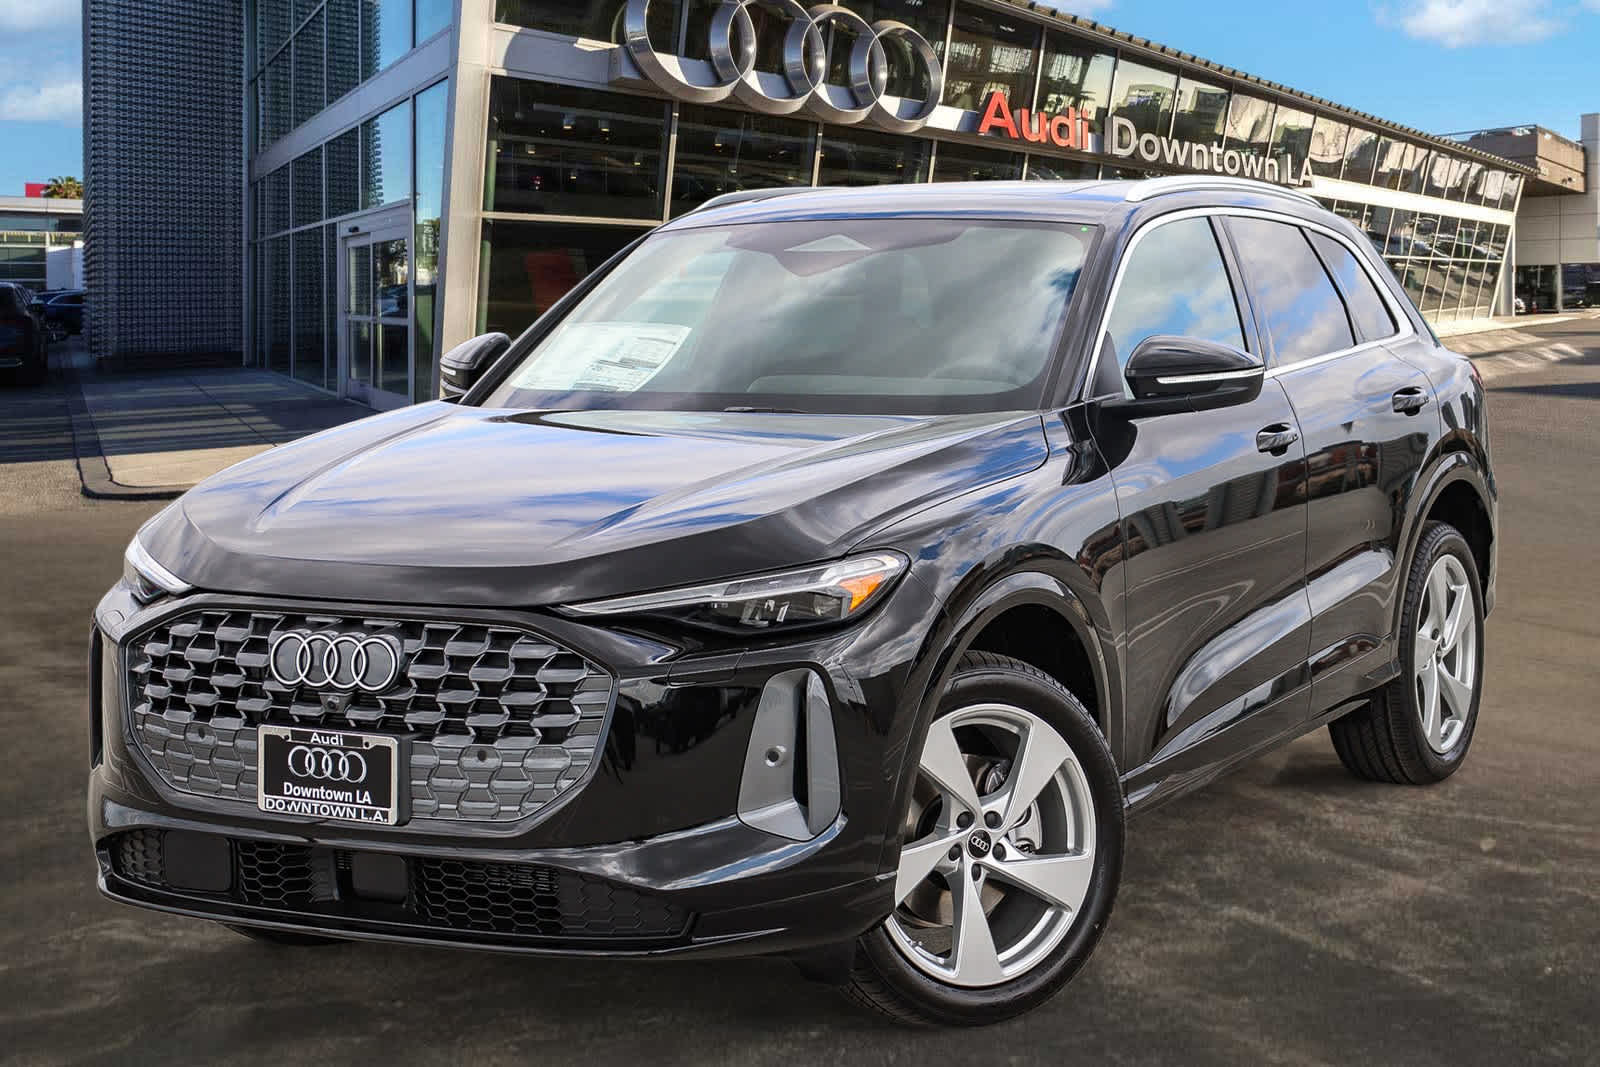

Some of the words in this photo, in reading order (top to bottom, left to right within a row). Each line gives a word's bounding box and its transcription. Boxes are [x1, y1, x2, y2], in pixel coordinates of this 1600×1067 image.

[978, 91, 1089, 151] Audi
[1109, 115, 1279, 183] Downtown
[1285, 154, 1315, 186] LA
[310, 732, 344, 746] Audi
[283, 782, 353, 802] Downtown
[356, 790, 372, 804] LA
[265, 798, 357, 819] DOWNTOWN
[360, 807, 388, 822] L.A.
